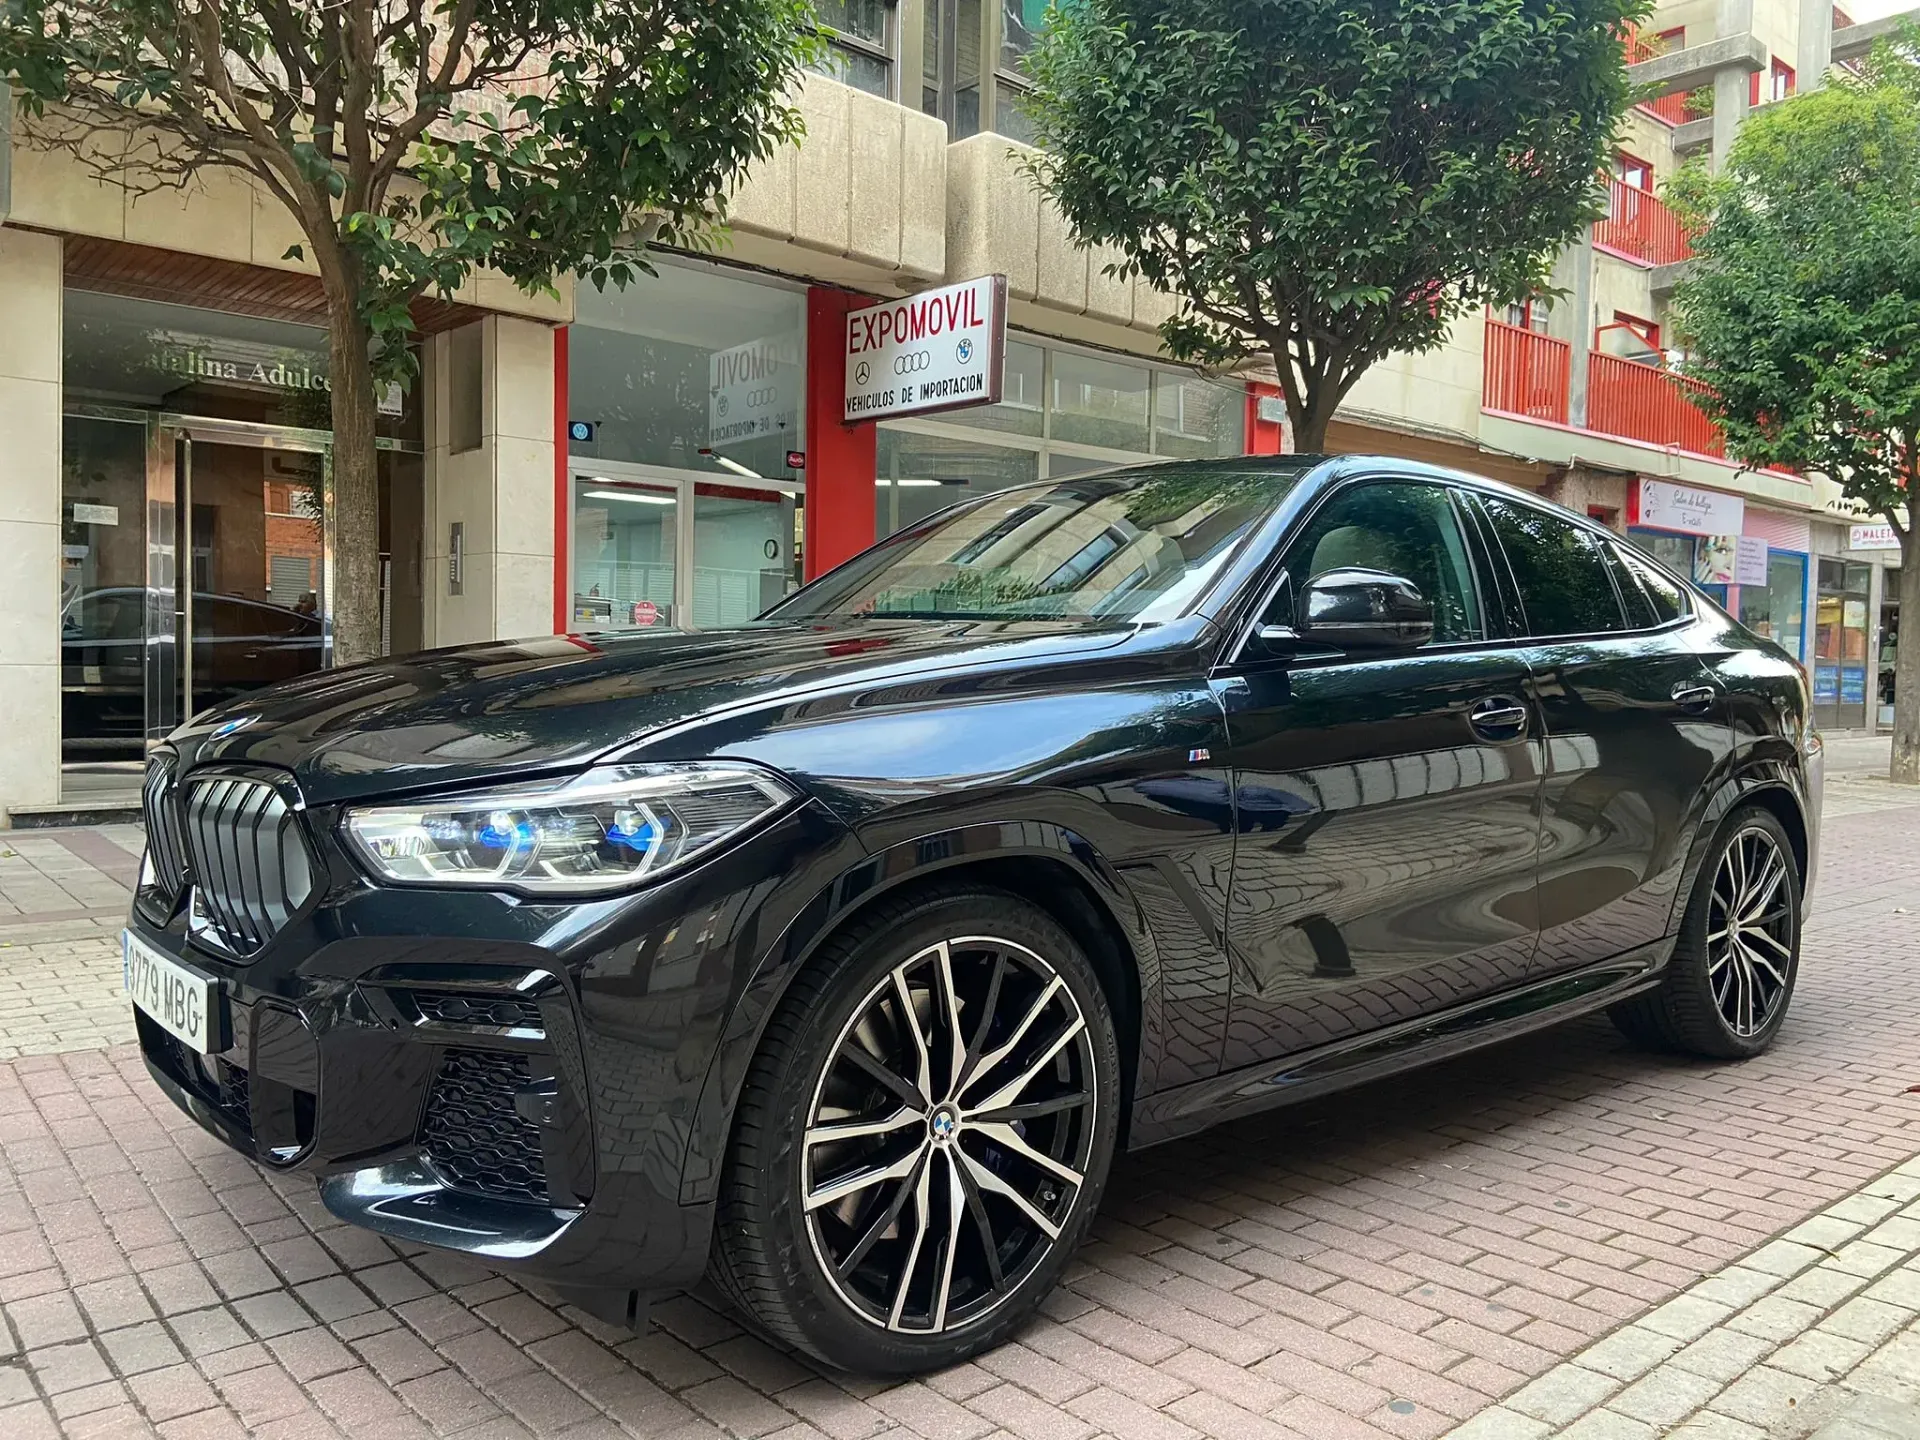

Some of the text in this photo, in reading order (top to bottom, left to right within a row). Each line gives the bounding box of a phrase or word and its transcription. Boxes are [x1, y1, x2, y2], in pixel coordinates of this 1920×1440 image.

[849, 287, 984, 354] EXPOMOVIL
[846, 373, 983, 413] VEHICULOS DE IMPORTACION
[128, 944, 198, 1037] 9779 MBG
